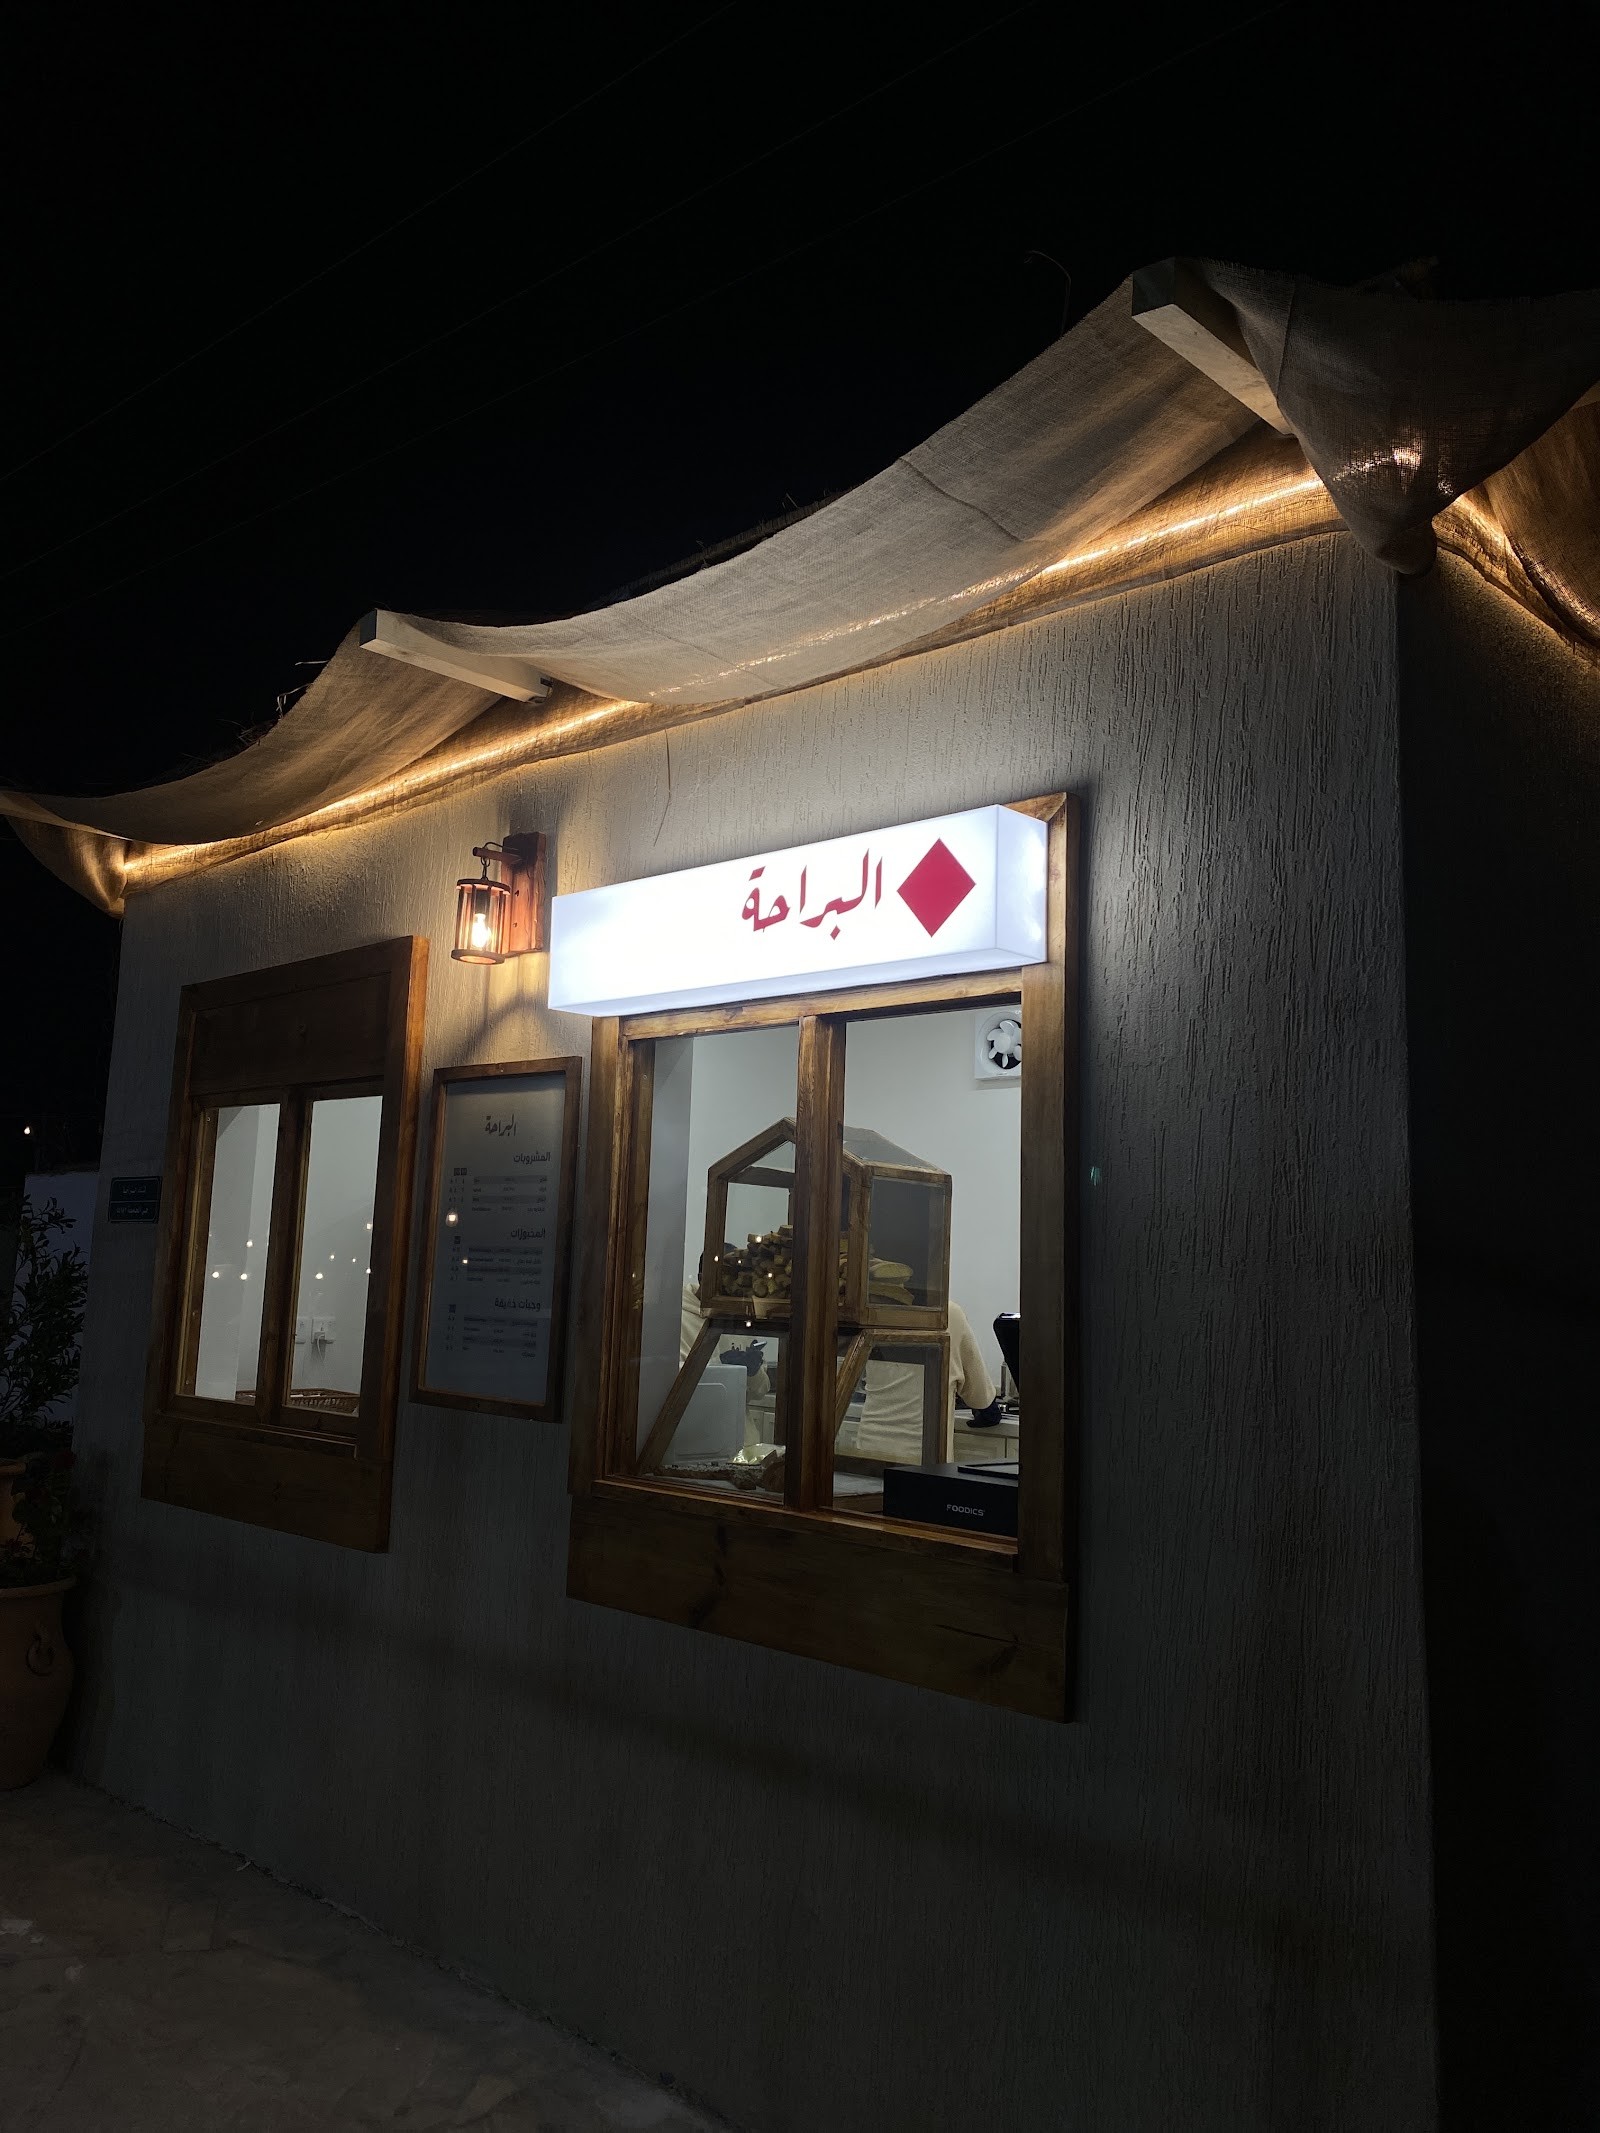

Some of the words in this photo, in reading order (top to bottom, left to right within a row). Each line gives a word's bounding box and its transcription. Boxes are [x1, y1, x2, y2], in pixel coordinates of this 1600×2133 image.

[742, 848, 882, 940] البراحة
[485, 1113, 517, 1136] البراحة
[513, 1150, 551, 1165] المشروبات
[946, 1504, 984, 1516] FOODICS
